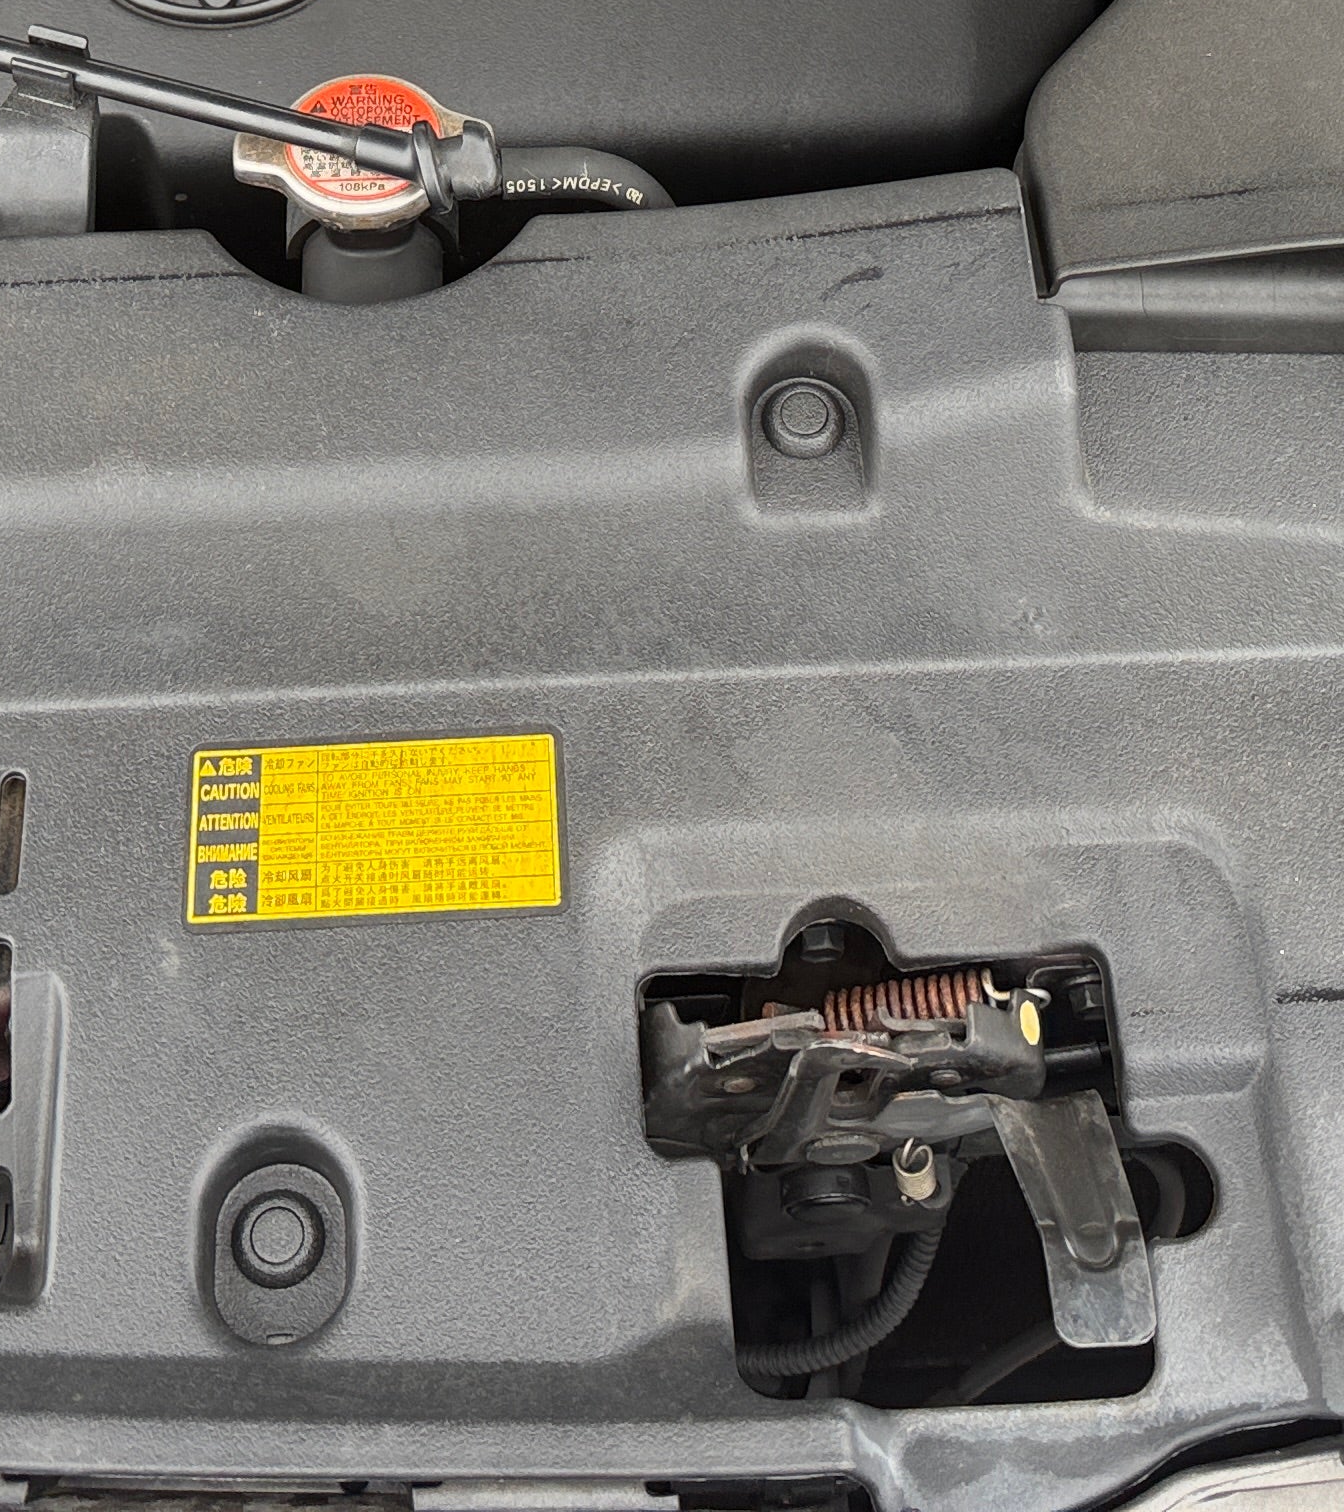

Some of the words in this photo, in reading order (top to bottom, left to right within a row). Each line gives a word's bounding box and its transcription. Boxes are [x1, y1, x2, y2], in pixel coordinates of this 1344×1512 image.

[330, 104, 413, 117] ОСТОРОЖНО
[331, 94, 405, 107] WARNING
[200, 781, 259, 801] CAUTION
[198, 811, 258, 831] ATTENTION
[197, 842, 257, 863] ВНИМАНИЕ
[209, 867, 247, 889] 危险
